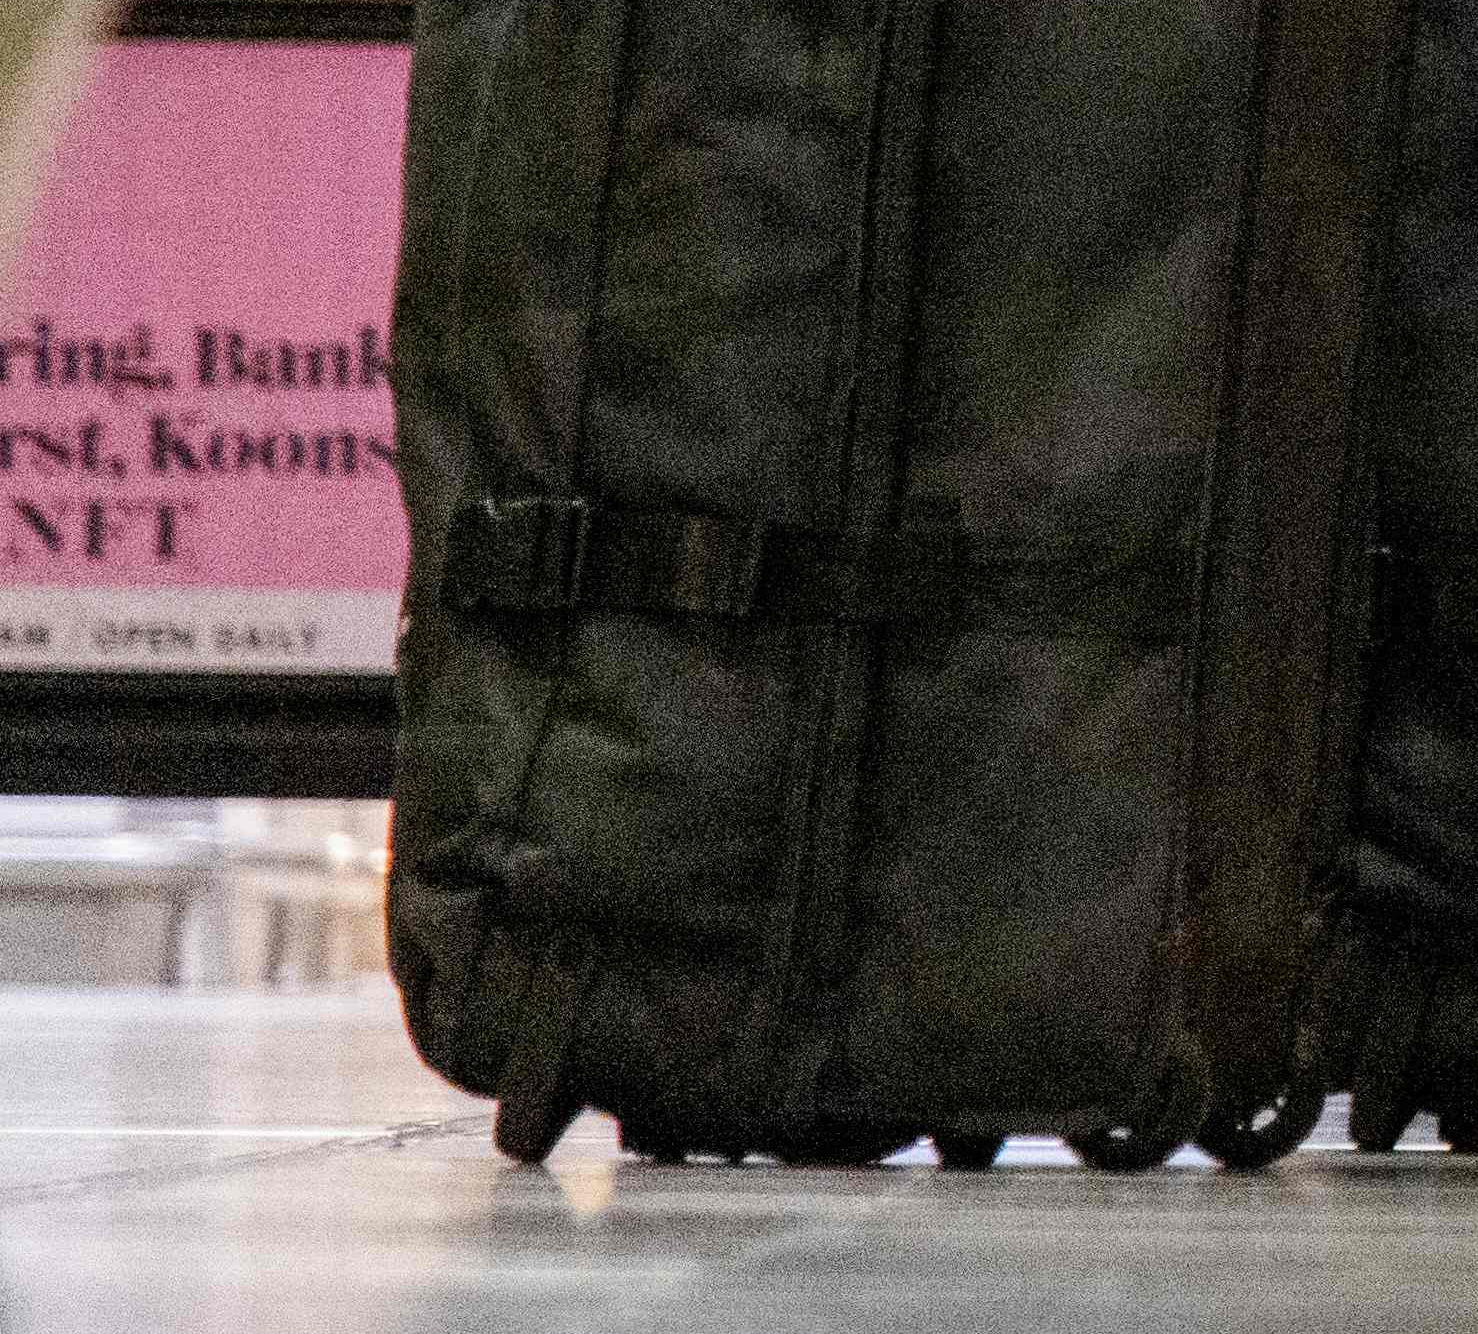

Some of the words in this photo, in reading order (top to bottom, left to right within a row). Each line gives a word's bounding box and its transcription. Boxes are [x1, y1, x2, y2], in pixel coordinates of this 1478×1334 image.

[0, 314, 173, 405] ring,
[194, 323, 393, 388] Bank
[0, 415, 127, 481] rst,
